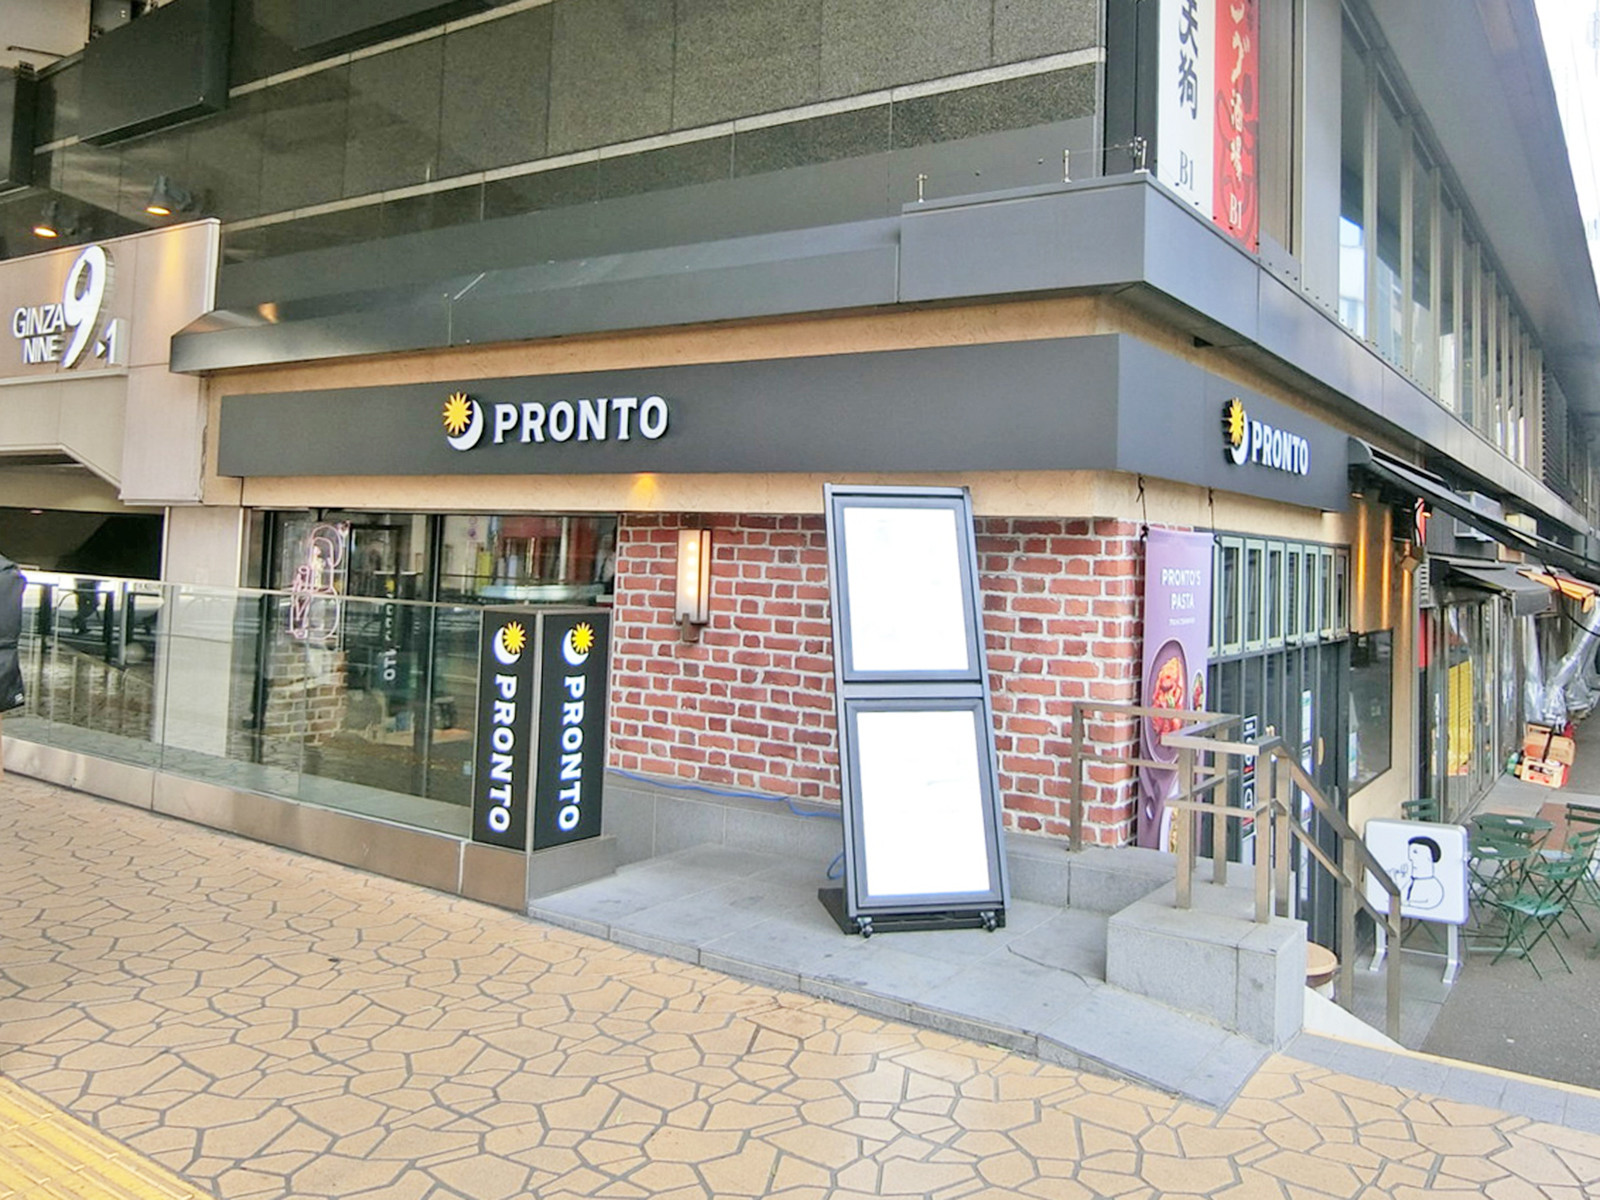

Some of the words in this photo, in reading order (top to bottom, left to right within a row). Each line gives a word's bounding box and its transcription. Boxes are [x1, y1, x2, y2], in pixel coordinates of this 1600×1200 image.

[13, 303, 66, 339] GINZA
[23, 335, 61, 364] NINE
[493, 396, 669, 444] PRONTO
[1251, 420, 1310, 476] PRONTO
[1161, 568, 1201, 586] PRONTO'S
[1171, 593, 1195, 610] PASTA
[488, 674, 518, 833] PRONTO
[556, 675, 586, 832] PRONTO
